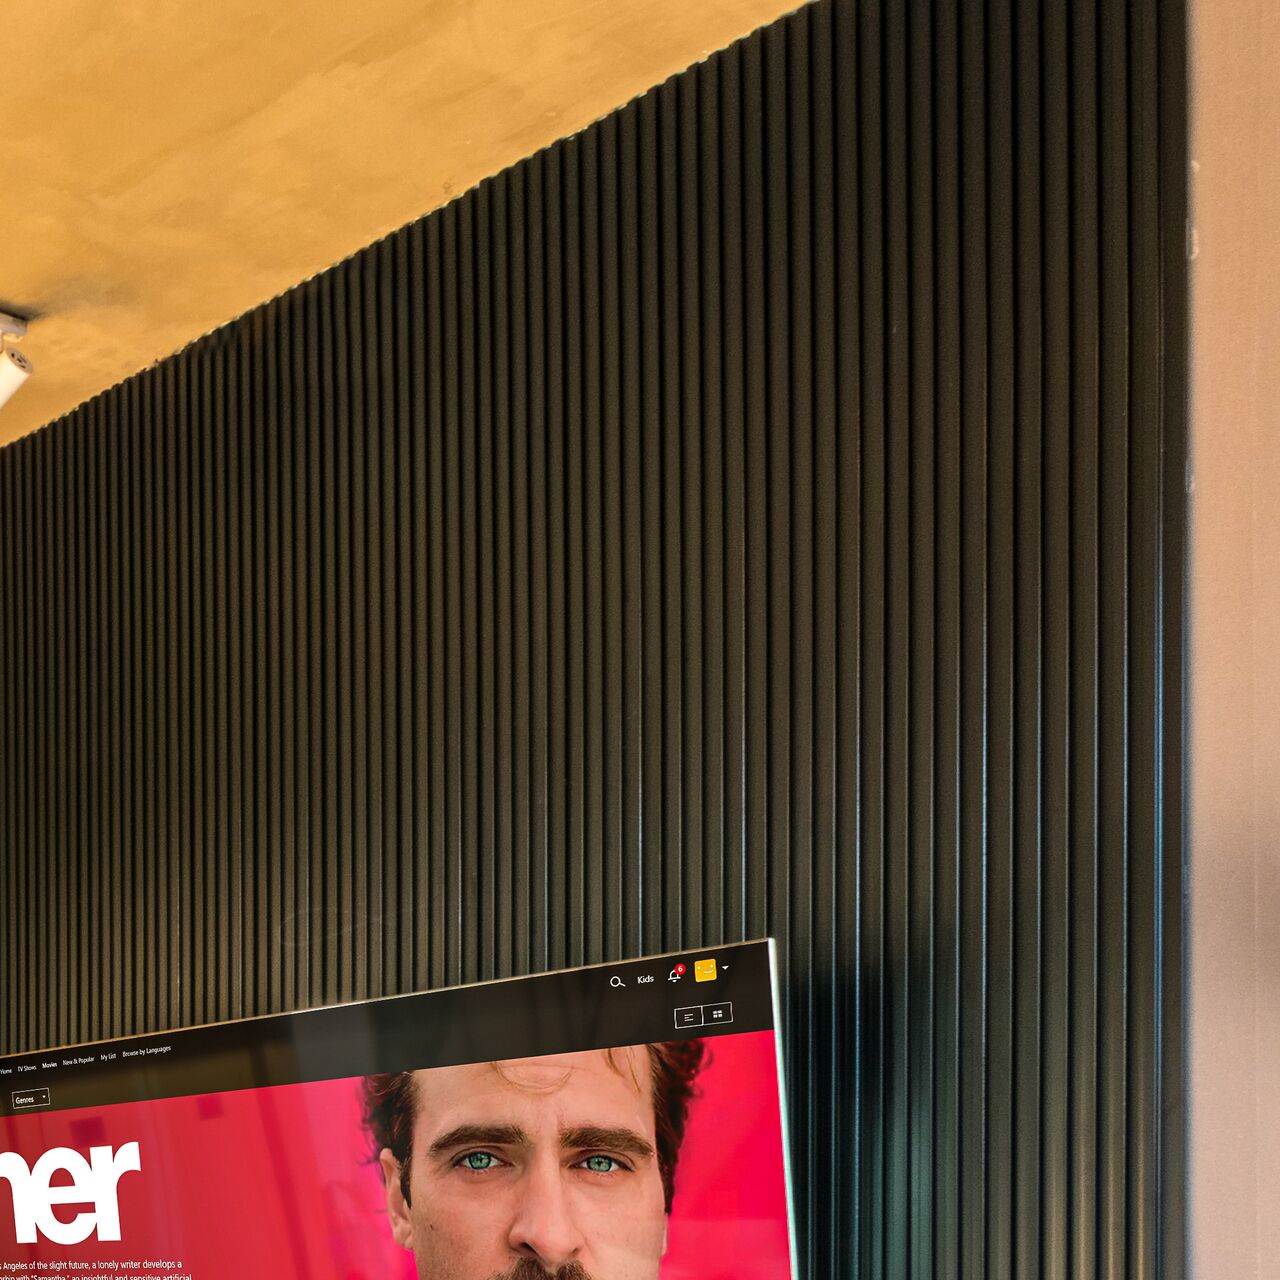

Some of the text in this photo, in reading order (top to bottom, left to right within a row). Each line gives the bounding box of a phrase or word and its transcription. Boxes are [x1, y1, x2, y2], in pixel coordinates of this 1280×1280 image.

[637, 975, 655, 984] Kids
[122, 1050, 138, 1058] Browse
[146, 1045, 172, 1055] Languages
[78, 1056, 94, 1065] Popular
[15, 1096, 34, 1104] Genres
[3, 1262, 27, 1272] Angeles
[29, 1261, 35, 1270] of
[37, 1261, 47, 1269] the
[49, 1261, 67, 1271] slight
[67, 1261, 90, 1270] future,
[98, 1260, 118, 1271] lonely
[120, 1260, 140, 1269] writer
[142, 1259, 175, 1270] develops
